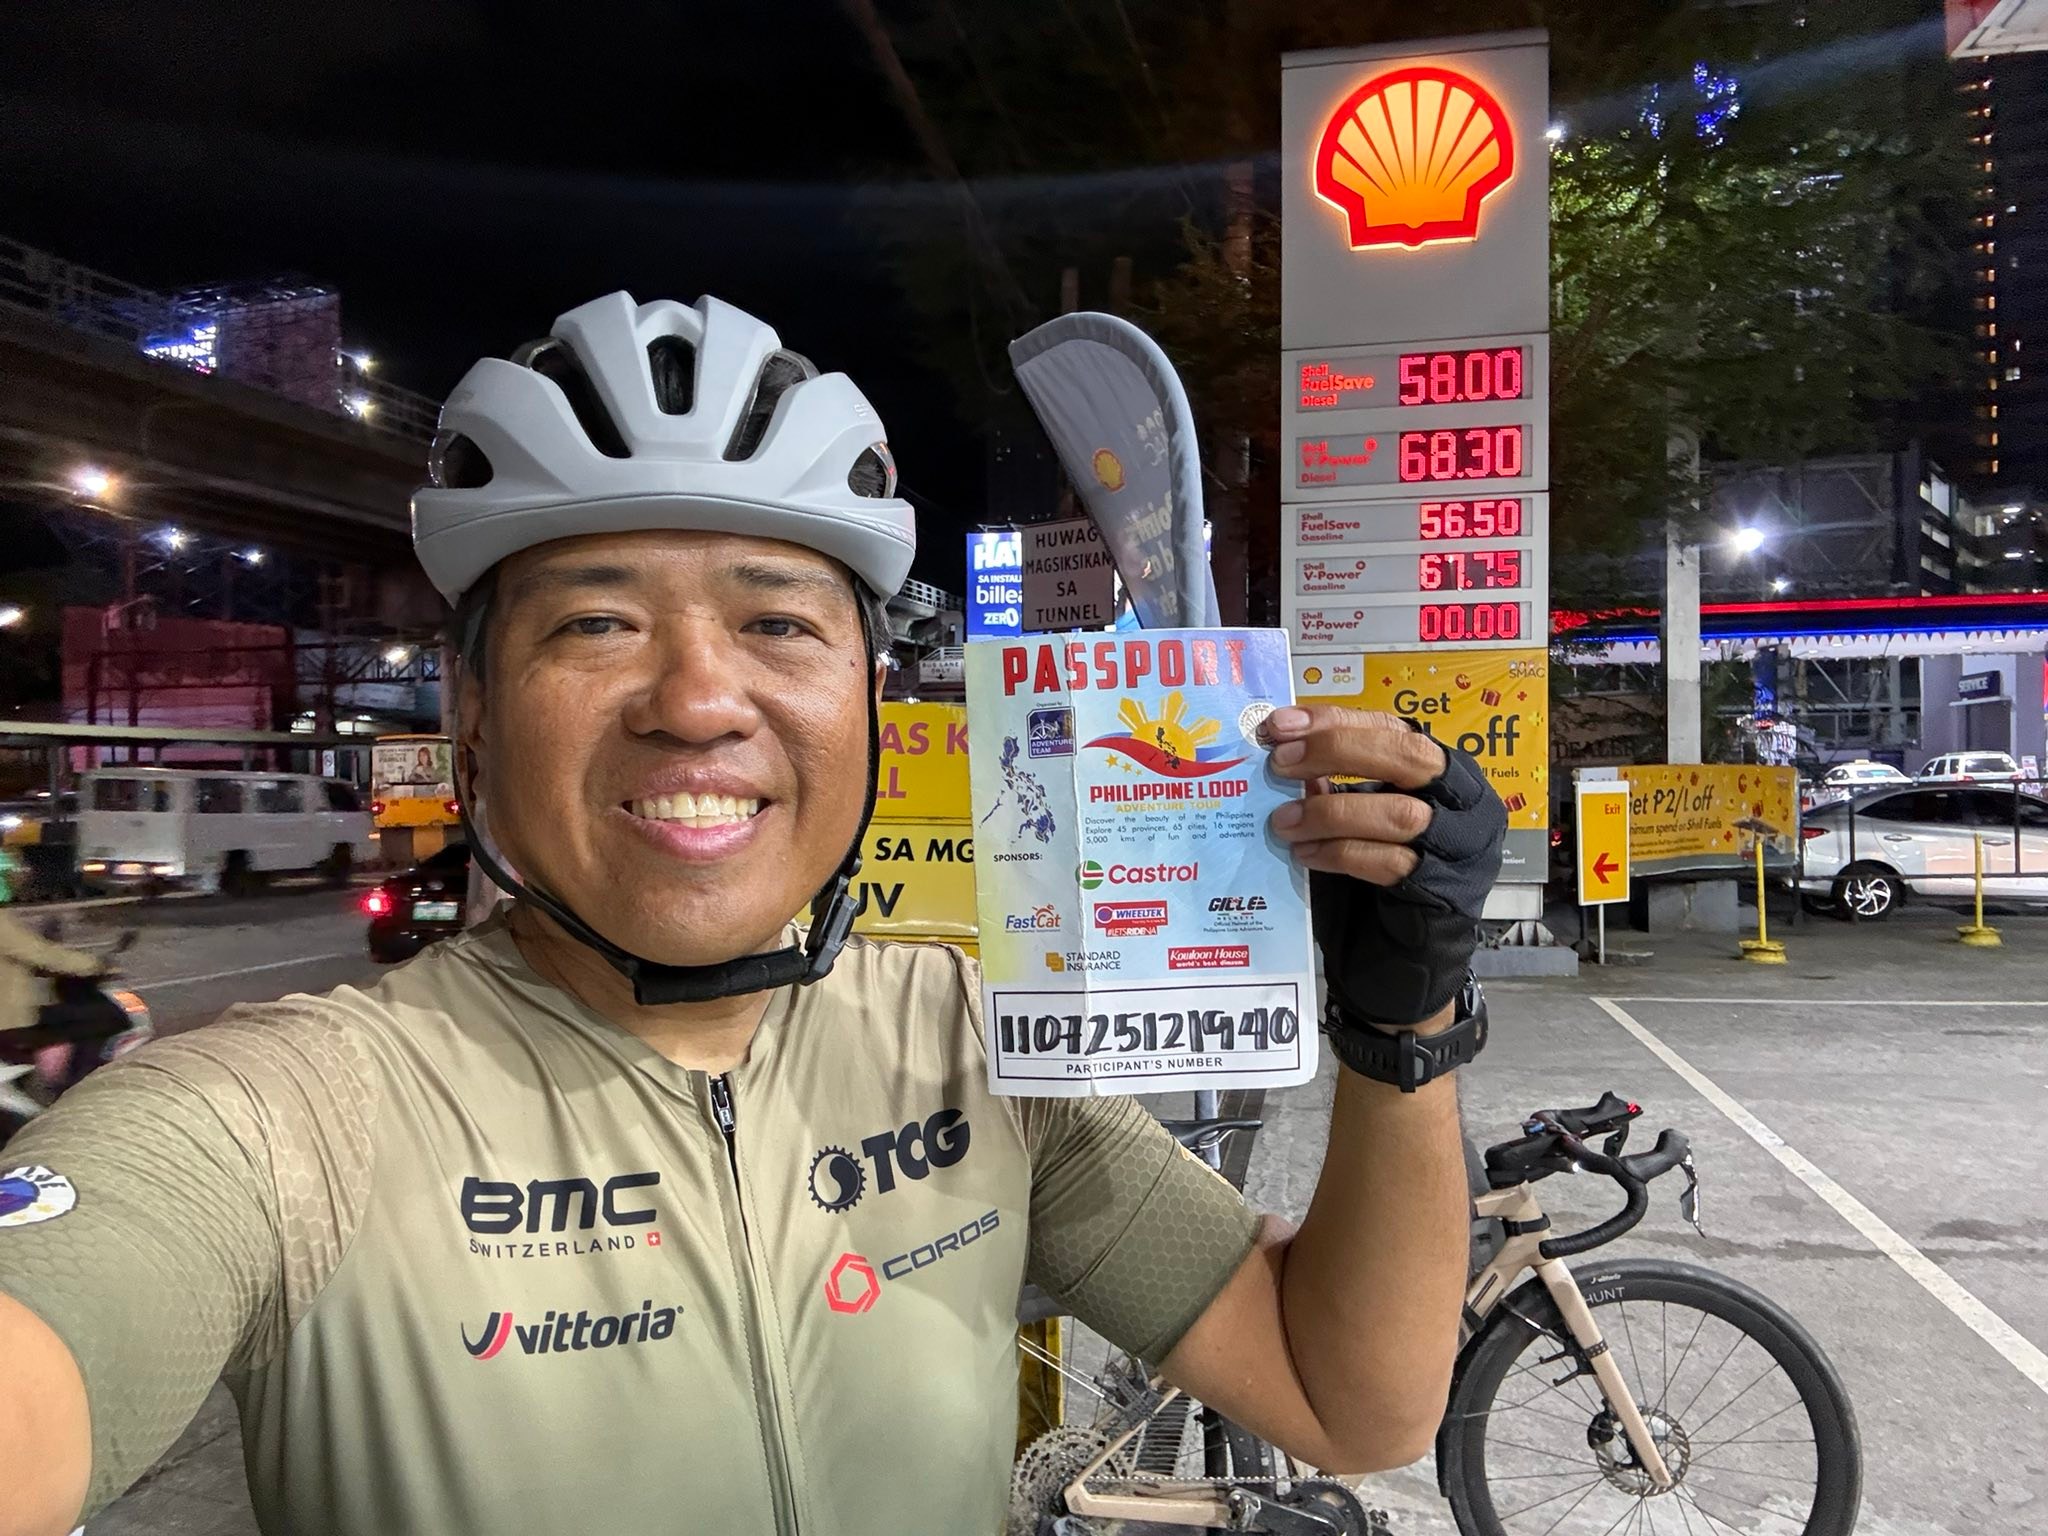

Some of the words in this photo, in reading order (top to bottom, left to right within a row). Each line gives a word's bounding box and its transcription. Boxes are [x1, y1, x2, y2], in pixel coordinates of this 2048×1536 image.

[1302, 363, 1329, 377] Shell
[1400, 350, 1522, 405] 58.00
[1302, 374, 1375, 392] FuelSave
[1302, 394, 1338, 407] Diesel
[1400, 427, 1522, 482] 68.30
[1301, 512, 1324, 522] Shell
[1420, 500, 1519, 539] 56.50
[1301, 519, 1361, 531] FuelSave
[1036, 527, 1098, 549] HUWAG
[1301, 532, 1344, 542] Gasoline
[1025, 551, 1112, 575] MAGSIKSIKAN
[1303, 562, 1326, 572] Shell
[1304, 571, 1362, 581] V-Power
[1420, 551, 1519, 591] 67.75
[978, 575, 989, 583] SA
[1056, 582, 1078, 597] SA
[1303, 582, 1346, 592] Gasoline
[1036, 604, 1101, 625] TUNNEL
[1301, 612, 1323, 621] Shell
[1421, 603, 1520, 641] 00.00
[1302, 620, 1359, 630] V-Power
[1301, 632, 1334, 642] Racing
[1002, 639, 1246, 696] PASSPORT
[1333, 665, 1352, 673] Shell
[1509, 667, 1546, 679] SMAC
[1959, 676, 1989, 692] SERVICE
[1394, 690, 1451, 715] Get
[880, 722, 930, 755] AS
[1457, 714, 1520, 757] off
[1031, 739, 1074, 748] ADVENTURE
[1491, 766, 1520, 778] Fuels
[1090, 782, 1194, 803] PHILIPPINE
[1198, 780, 1249, 798] LOOP
[1115, 802, 1185, 813] ADVENTURE
[1190, 800, 1222, 810] TOUR
[1630, 788, 1649, 815] et
[1692, 784, 1715, 811] off
[1605, 803, 1621, 815] Exit
[1085, 816, 1116, 825] Discover
[1124, 815, 1136, 823] the
[1145, 814, 1170, 824] beauty
[1178, 813, 1186, 821] of
[1195, 813, 1207, 821] the
[1215, 811, 1255, 821] Philippines
[1085, 826, 1112, 836] Explore
[1116, 825, 1127, 833] 45
[1132, 824, 1168, 834] provinces,
[1172, 823, 1183, 831] 65
[1187, 823, 1208, 831] cities,
[1228, 821, 1255, 831] regions
[1086, 835, 1108, 845] 5,000
[1120, 834, 1135, 842] kms
[1148, 833, 1155, 841] of
[1168, 832, 1180, 841] fun
[1192, 832, 1207, 840] and
[1219, 831, 1256, 840] adventure
[874, 837, 915, 862] SA
[925, 839, 974, 863] MG
[993, 852, 1043, 862] SPONSORS:
[1108, 862, 1199, 885] Castrol
[1116, 908, 1163, 918] WHEELTEK
[1005, 913, 1062, 929] FastCat
[1066, 951, 1121, 961] STANDARD
[1170, 949, 1213, 961] Kowloon
[1214, 948, 1248, 959] House
[1066, 961, 1121, 971] INSURANCE
[1066, 1059, 1163, 1075] PARTICIPANT'S
[1167, 1057, 1223, 1069] NUMBER
[860, 1108, 971, 1195] TCG
[460, 1172, 660, 1234] BMC
[469, 1236, 636, 1258] SWITZERLAND
[882, 1208, 1001, 1281] COROS
[1585, 1286, 1625, 1304] HUNT
[515, 1300, 677, 1355] vittoria
